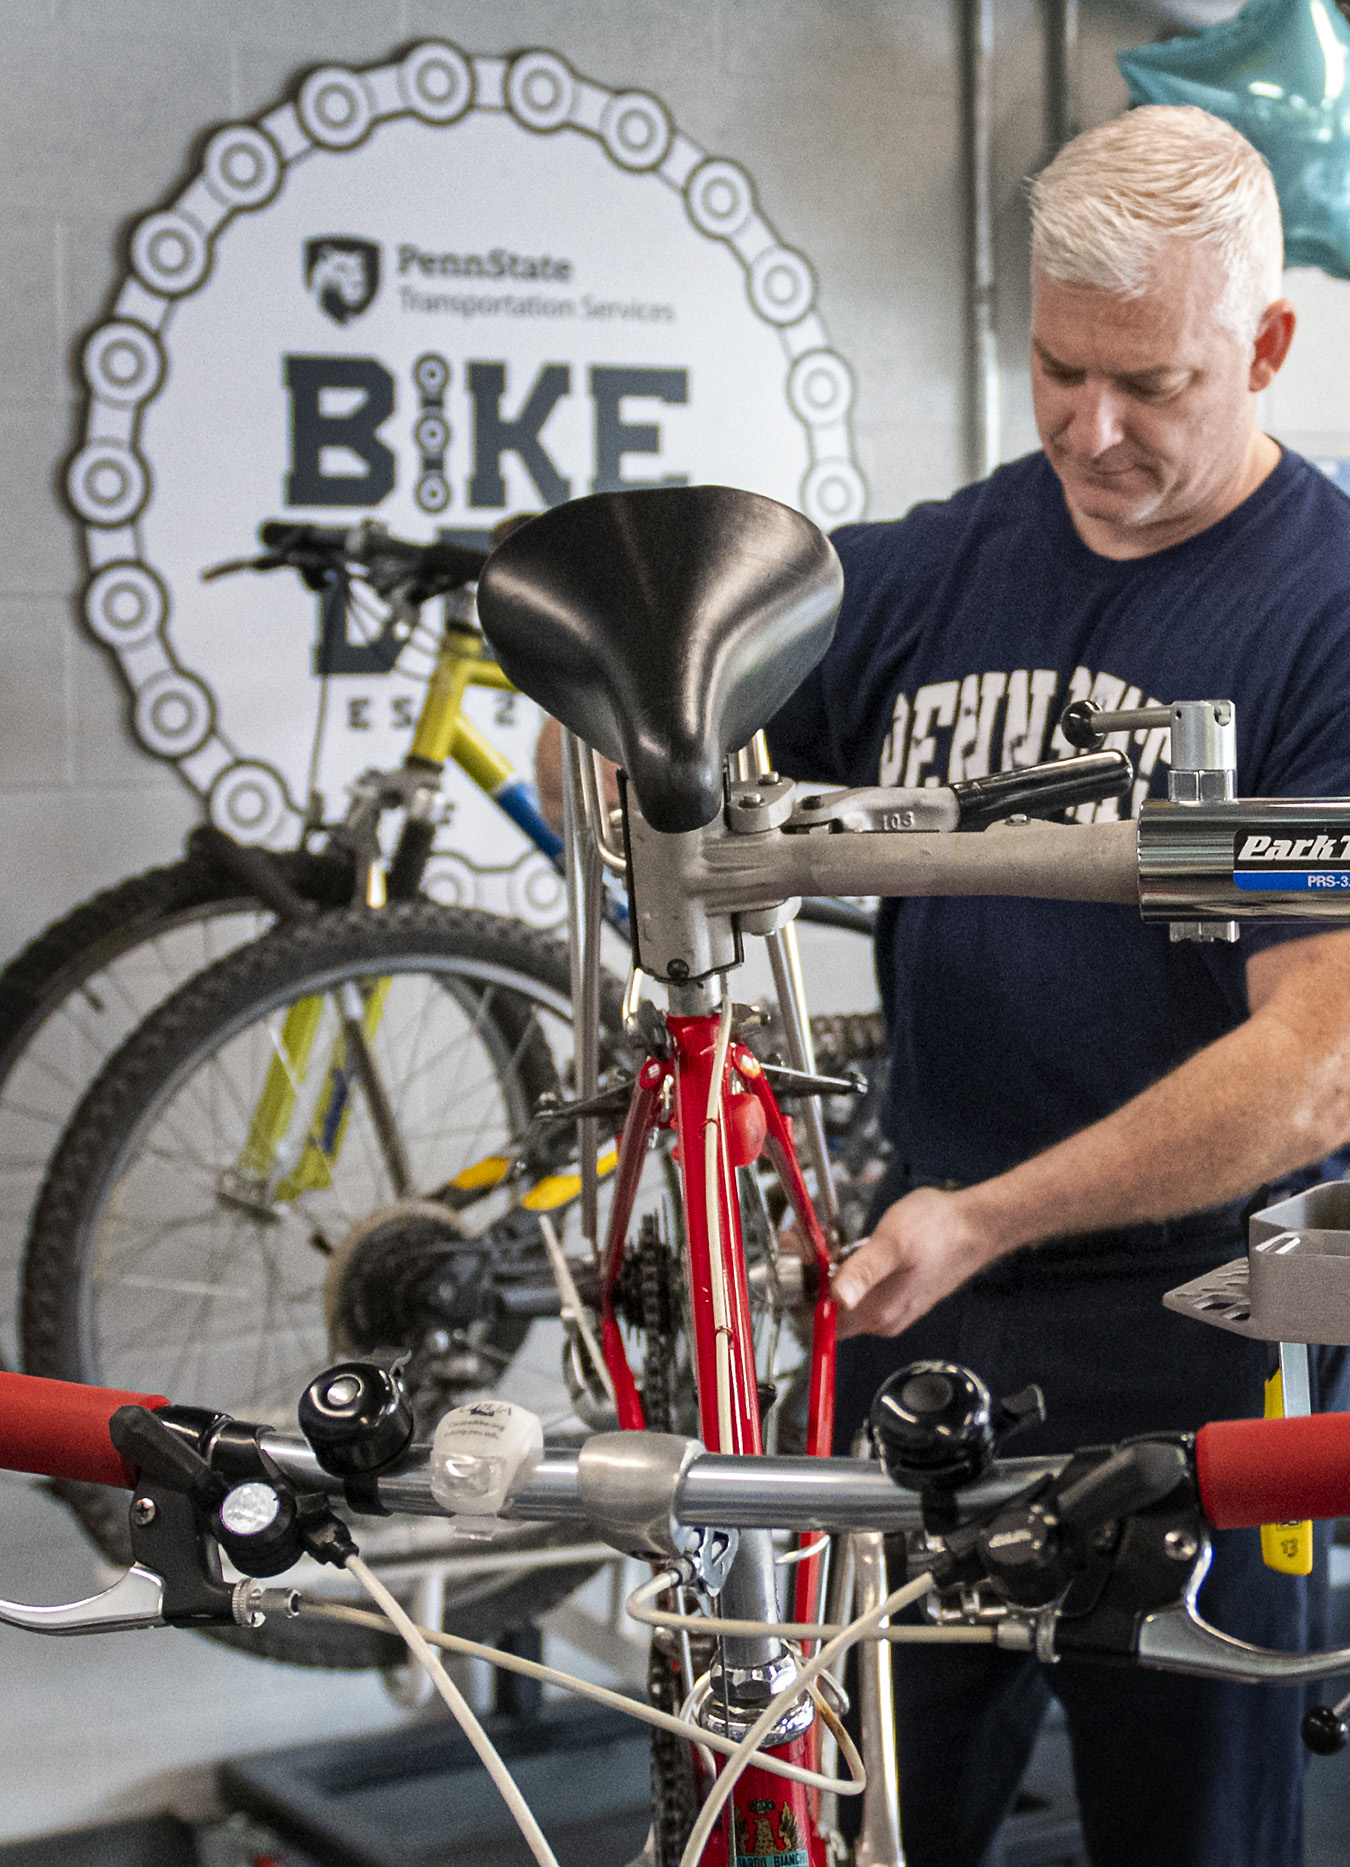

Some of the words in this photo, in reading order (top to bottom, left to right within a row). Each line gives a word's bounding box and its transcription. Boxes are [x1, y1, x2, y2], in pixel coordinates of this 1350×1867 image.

[400, 285, 575, 319] Transportation
[581, 294, 675, 323] Services
[284, 352, 690, 512] BIKE
